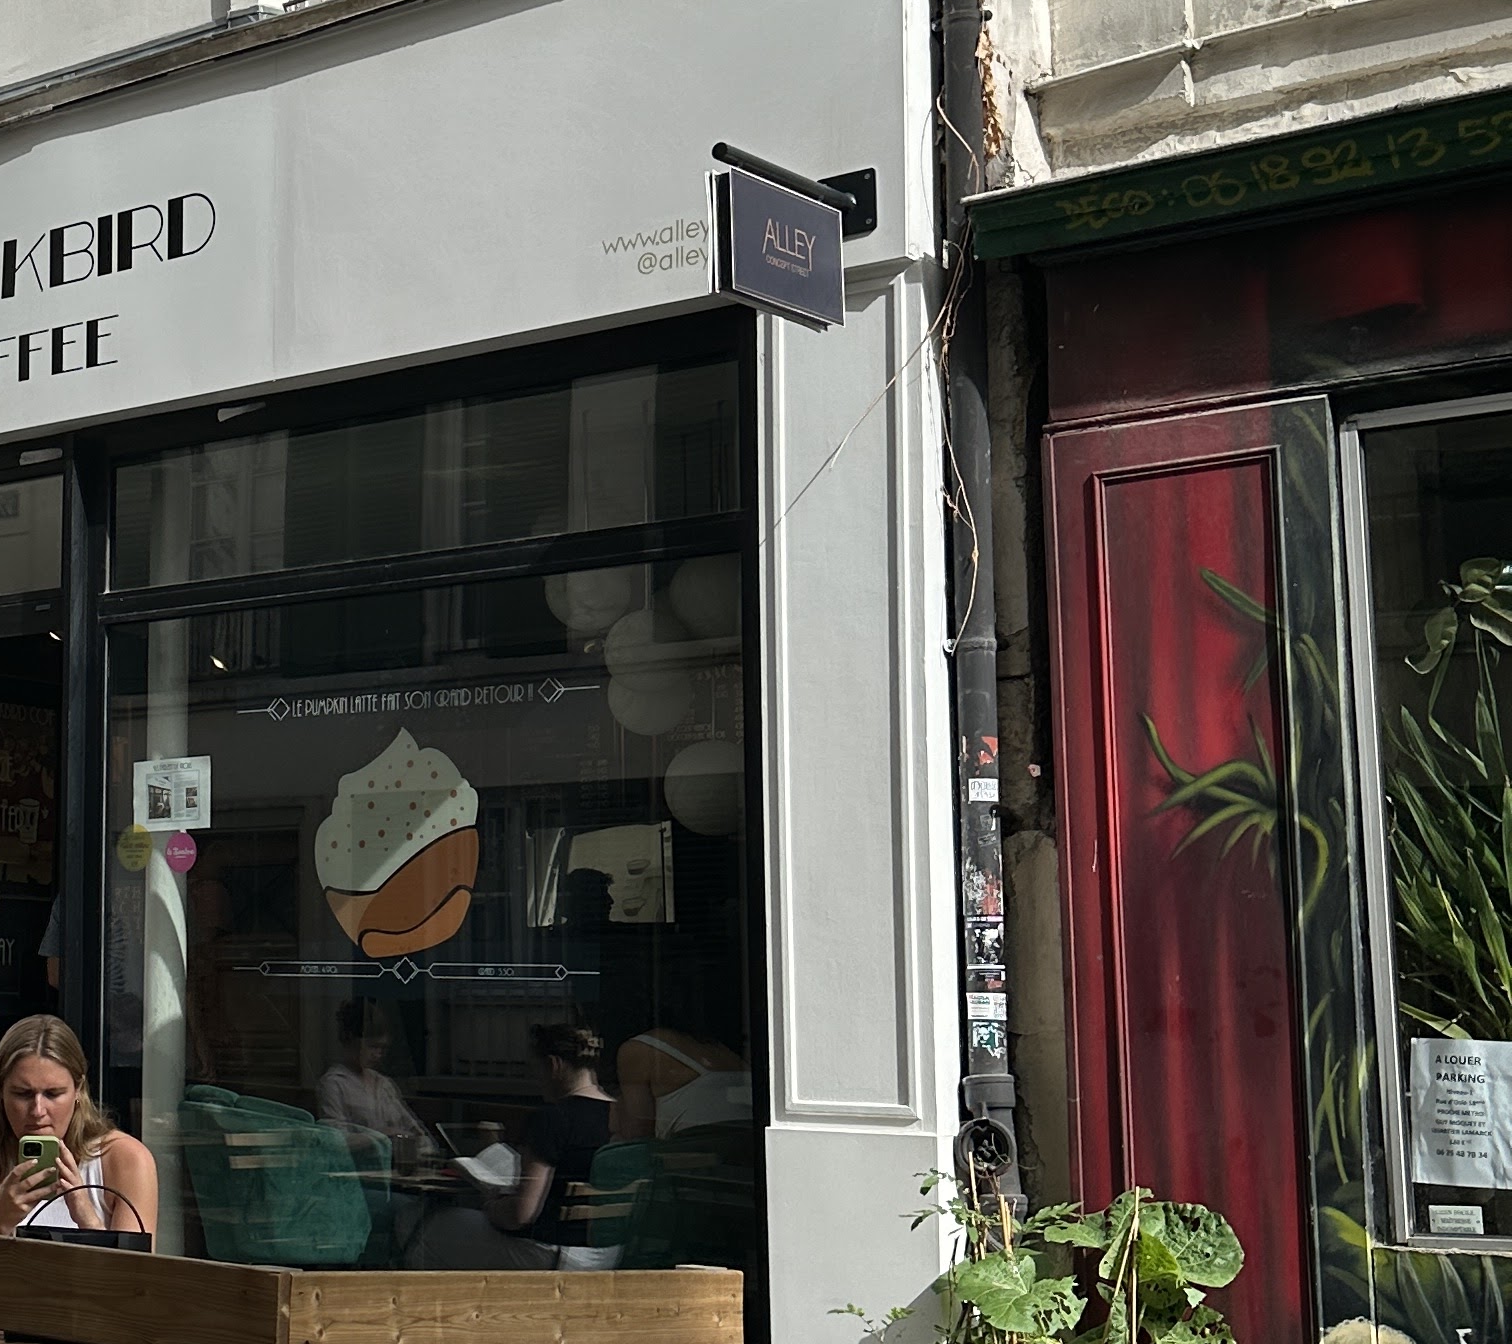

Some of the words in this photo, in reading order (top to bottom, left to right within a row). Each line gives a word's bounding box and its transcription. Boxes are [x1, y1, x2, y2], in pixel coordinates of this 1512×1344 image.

[762, 218, 816, 272] ALLEY
[291, 700, 303, 718] LE
[304, 697, 348, 717] PUMPKIN
[349, 693, 379, 714] LATTE
[380, 691, 401, 711] FAIT
[404, 690, 431, 710] SON
[434, 687, 471, 708] GRAND
[474, 683, 524, 705] RETOUR
[1435, 1054, 1442, 1064] A
[1444, 1055, 1482, 1066] LOUER
[1435, 1072, 1486, 1084] PARKING
